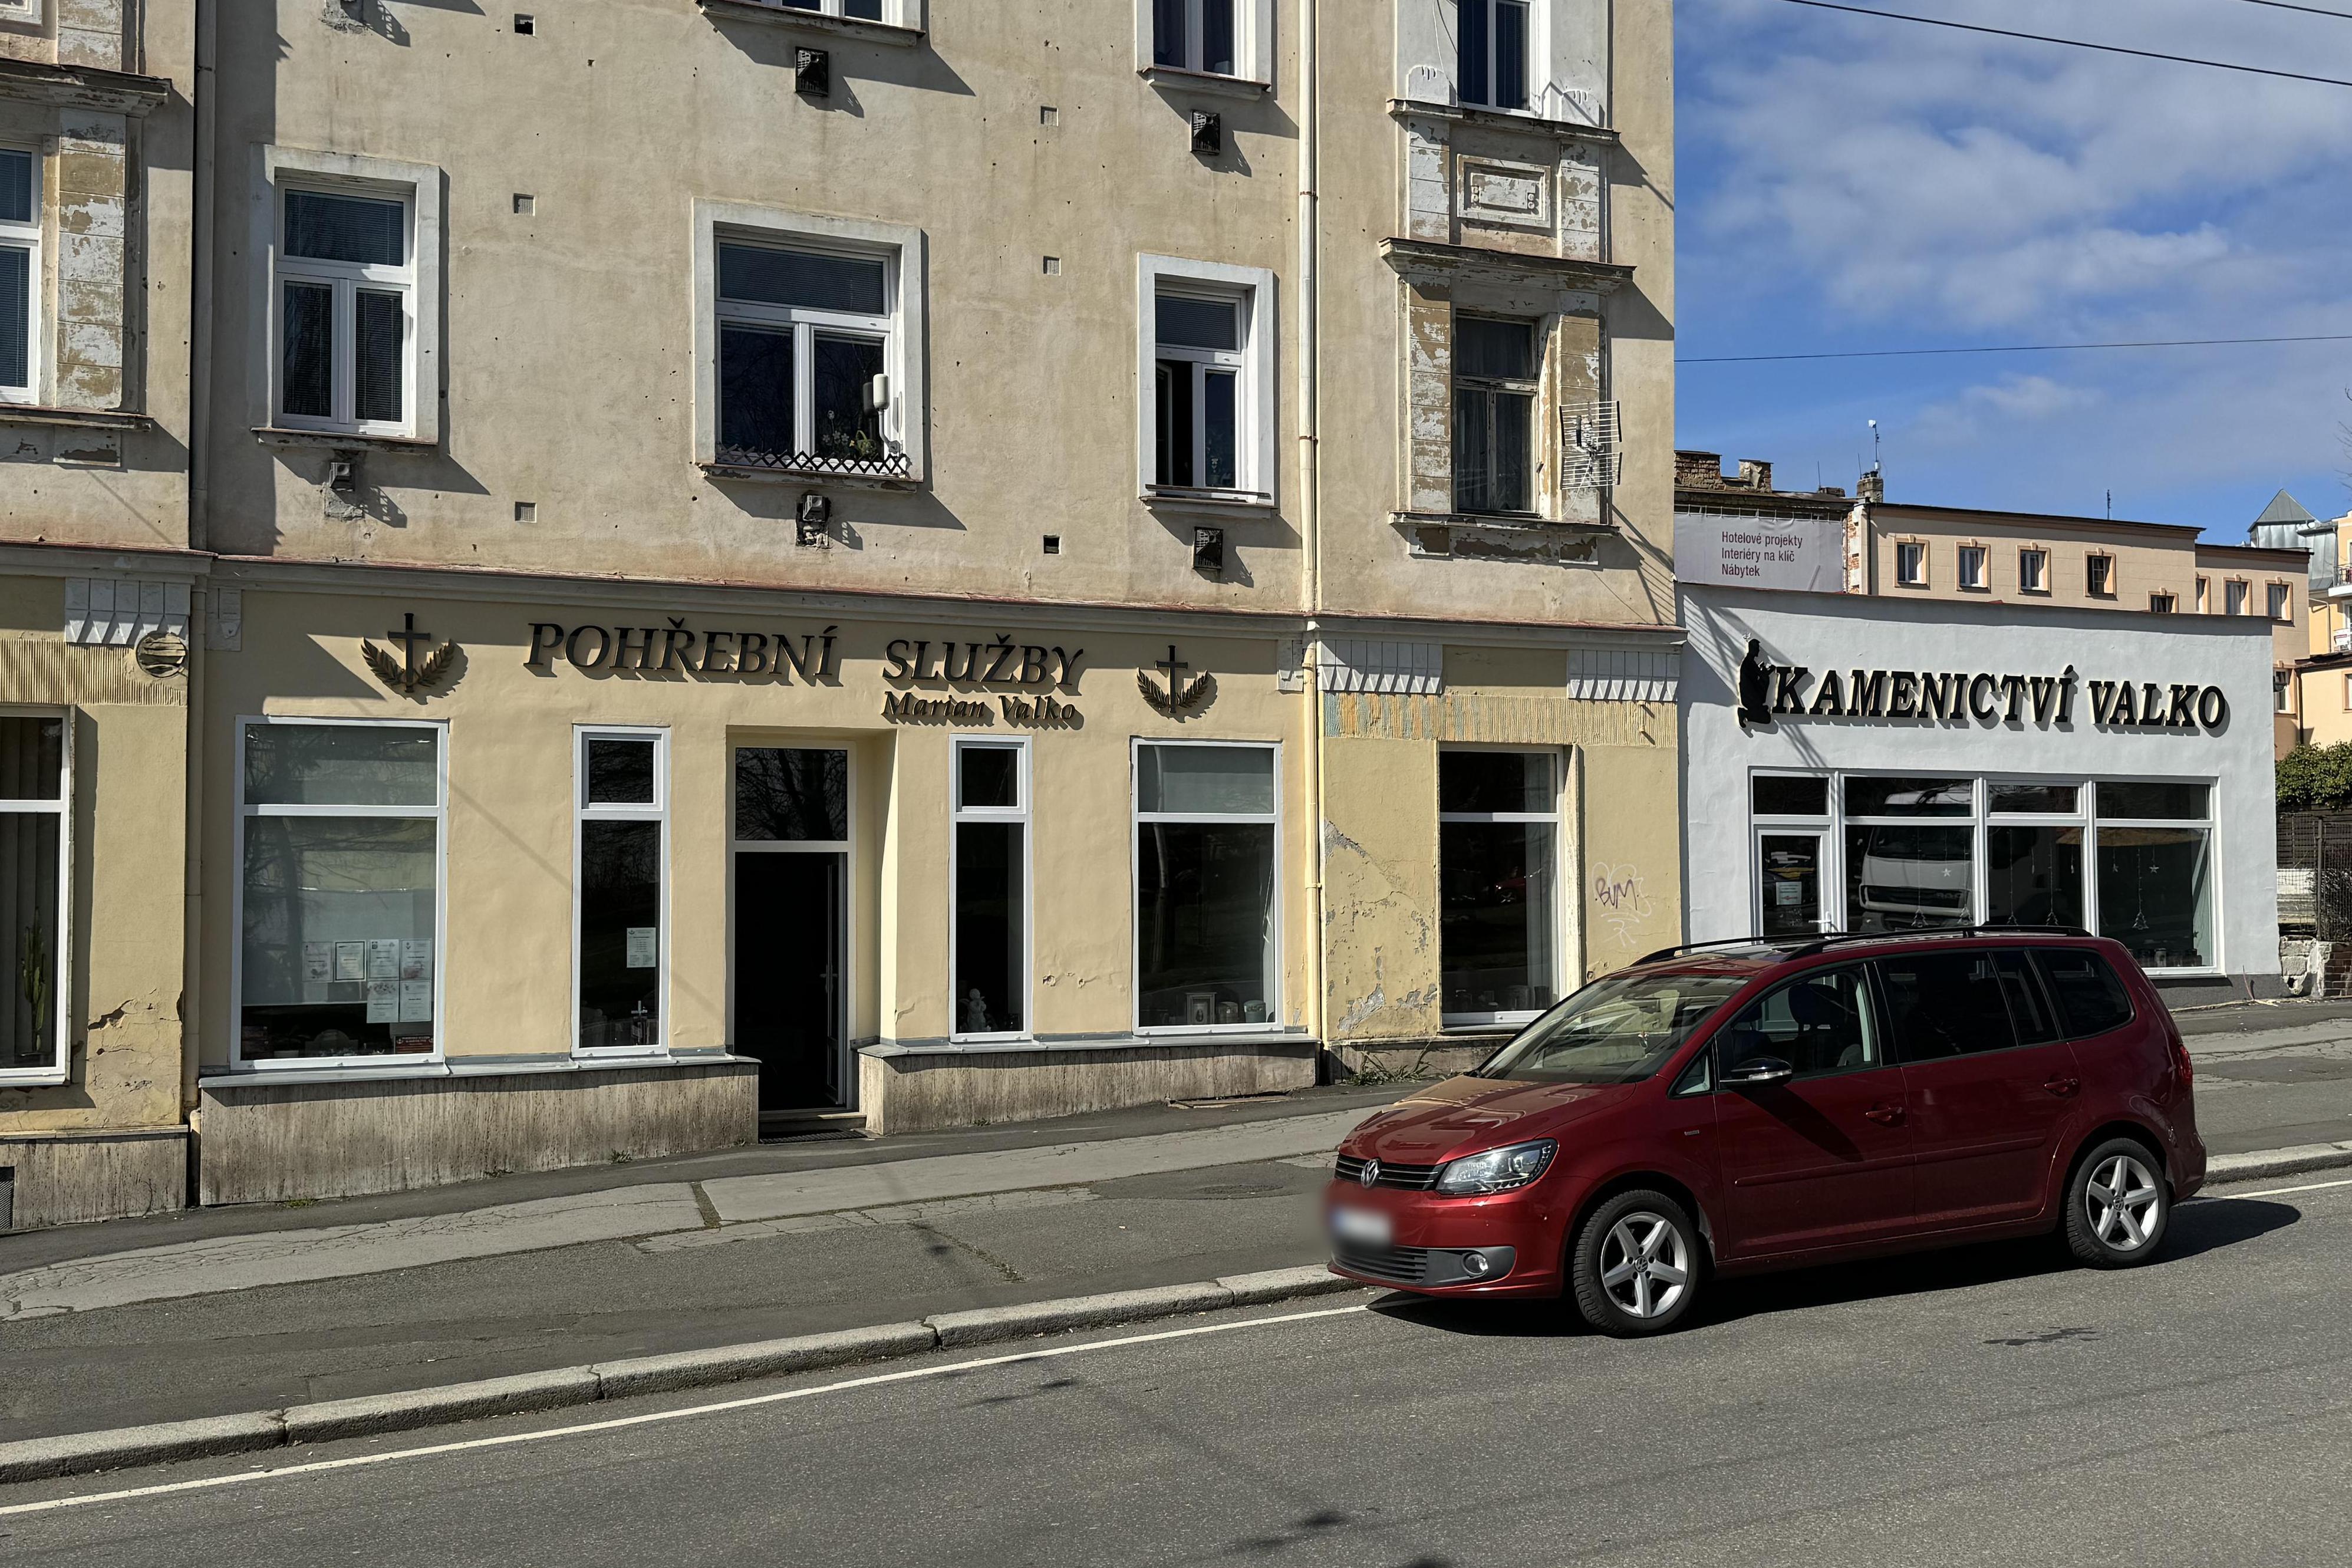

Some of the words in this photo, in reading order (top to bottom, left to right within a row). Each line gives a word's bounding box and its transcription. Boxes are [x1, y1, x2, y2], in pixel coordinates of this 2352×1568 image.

[1721, 531, 1762, 545] Hotelové
[1764, 535, 1803, 549] projekty
[1721, 548, 1761, 563] Interiéry
[1764, 551, 1775, 561] na
[1778, 550, 1795, 562] klíč
[1721, 564, 1760, 578] Nábytek
[522, 616, 839, 677] POHŘEBNÍ
[882, 633, 1084, 686] SLUŽBY
[882, 691, 985, 719] Marian
[998, 694, 1077, 721] Valko
[1772, 664, 2077, 723] KAMENICTVÍ
[2087, 679, 2226, 730] VALKO
